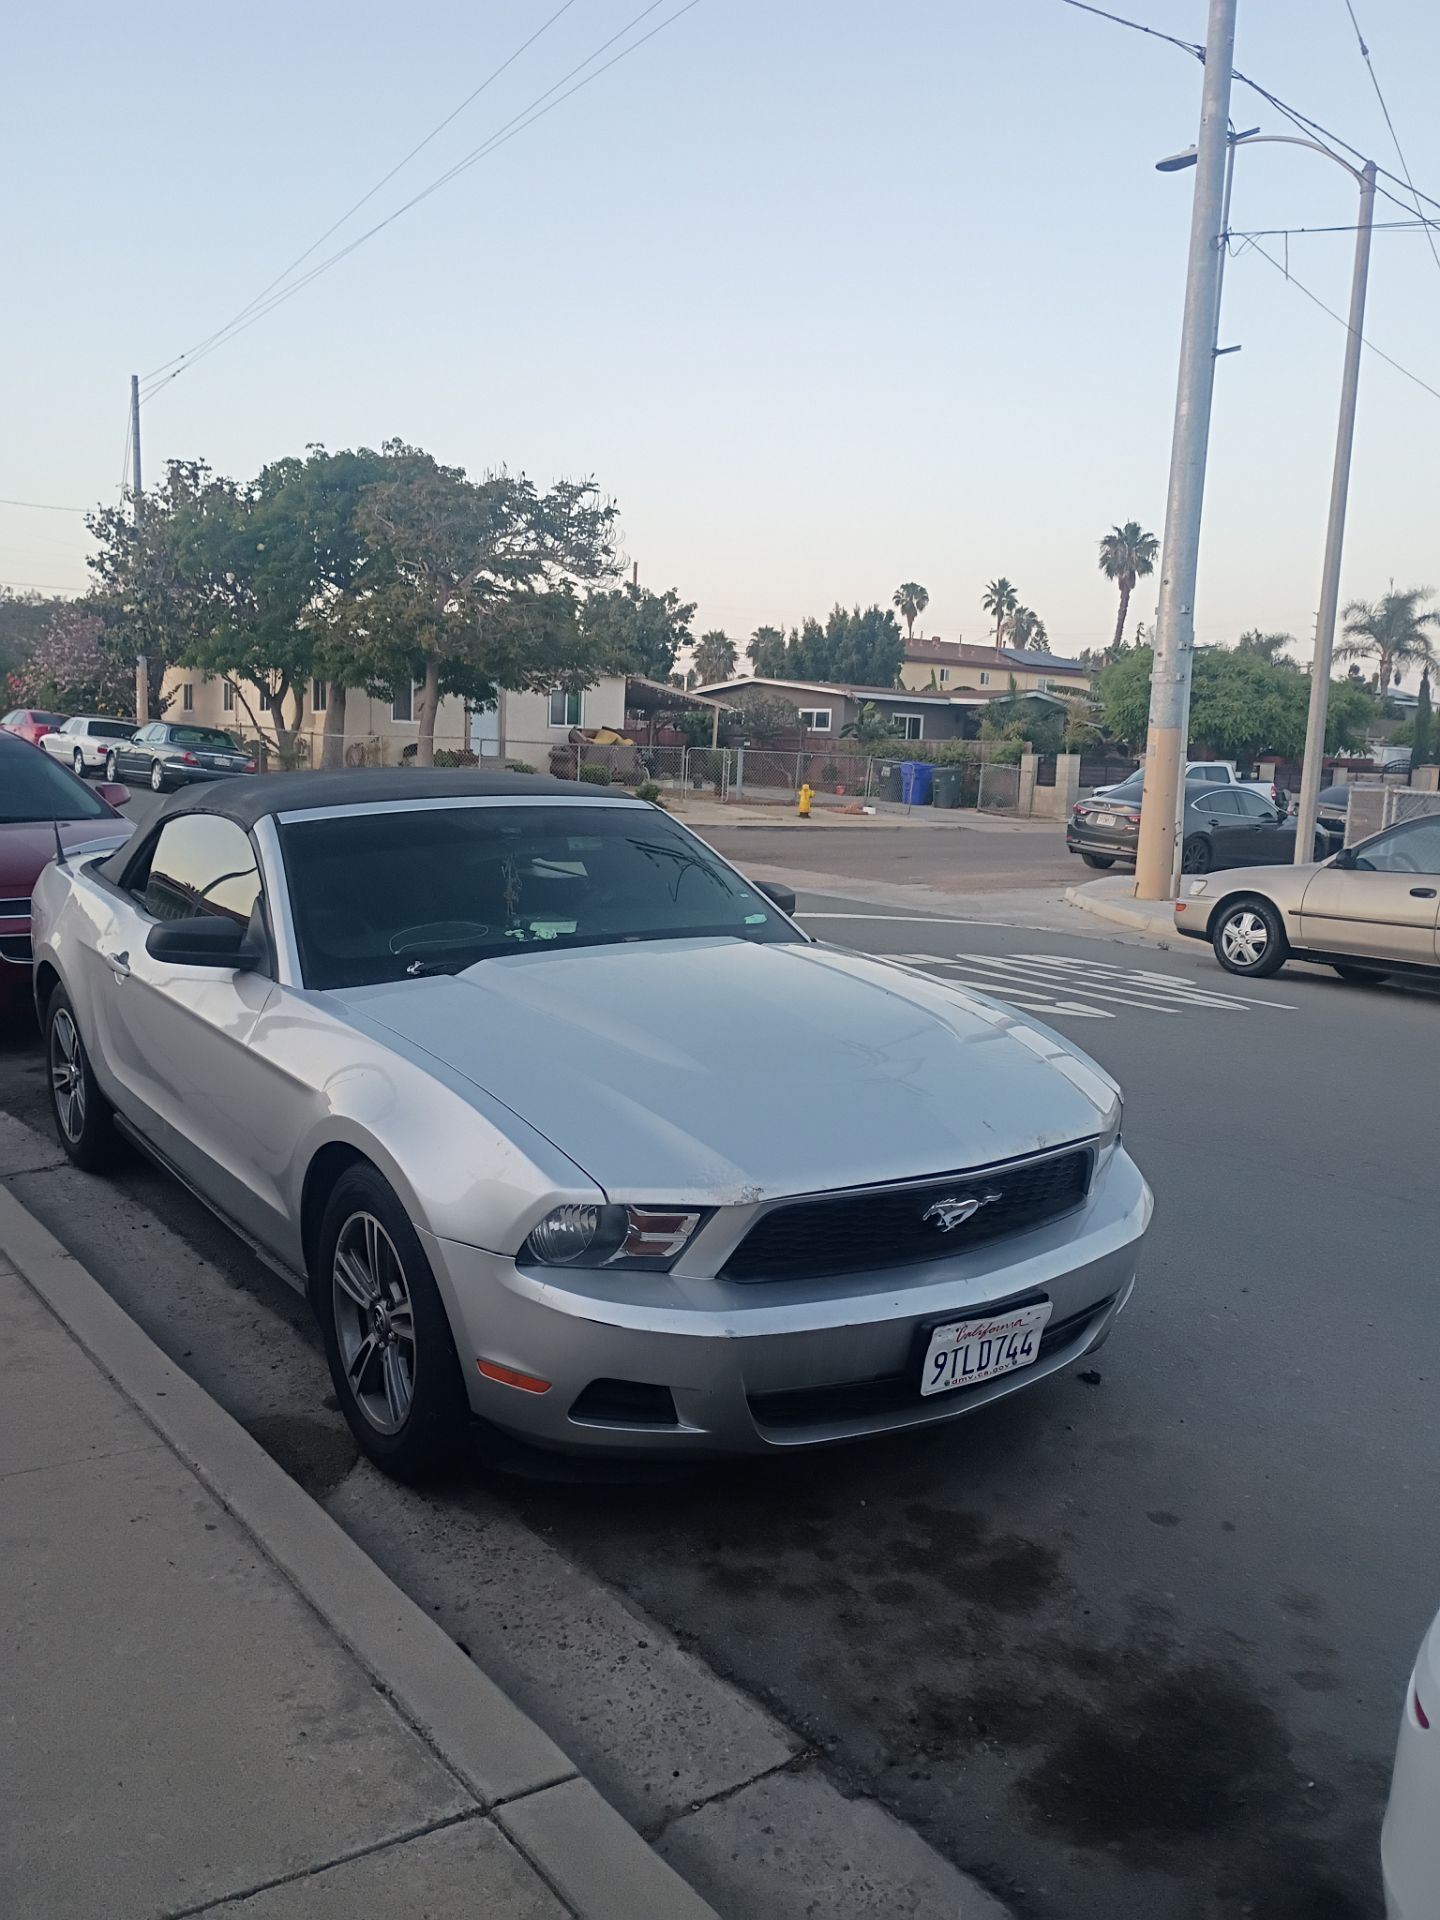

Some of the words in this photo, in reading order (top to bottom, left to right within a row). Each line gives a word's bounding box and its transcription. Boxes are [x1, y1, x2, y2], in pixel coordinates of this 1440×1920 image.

[956, 1317, 1029, 1343] California
[930, 1329, 1034, 1385] 9TLD744
[950, 1362, 1010, 1385] dmv.ca.gov
